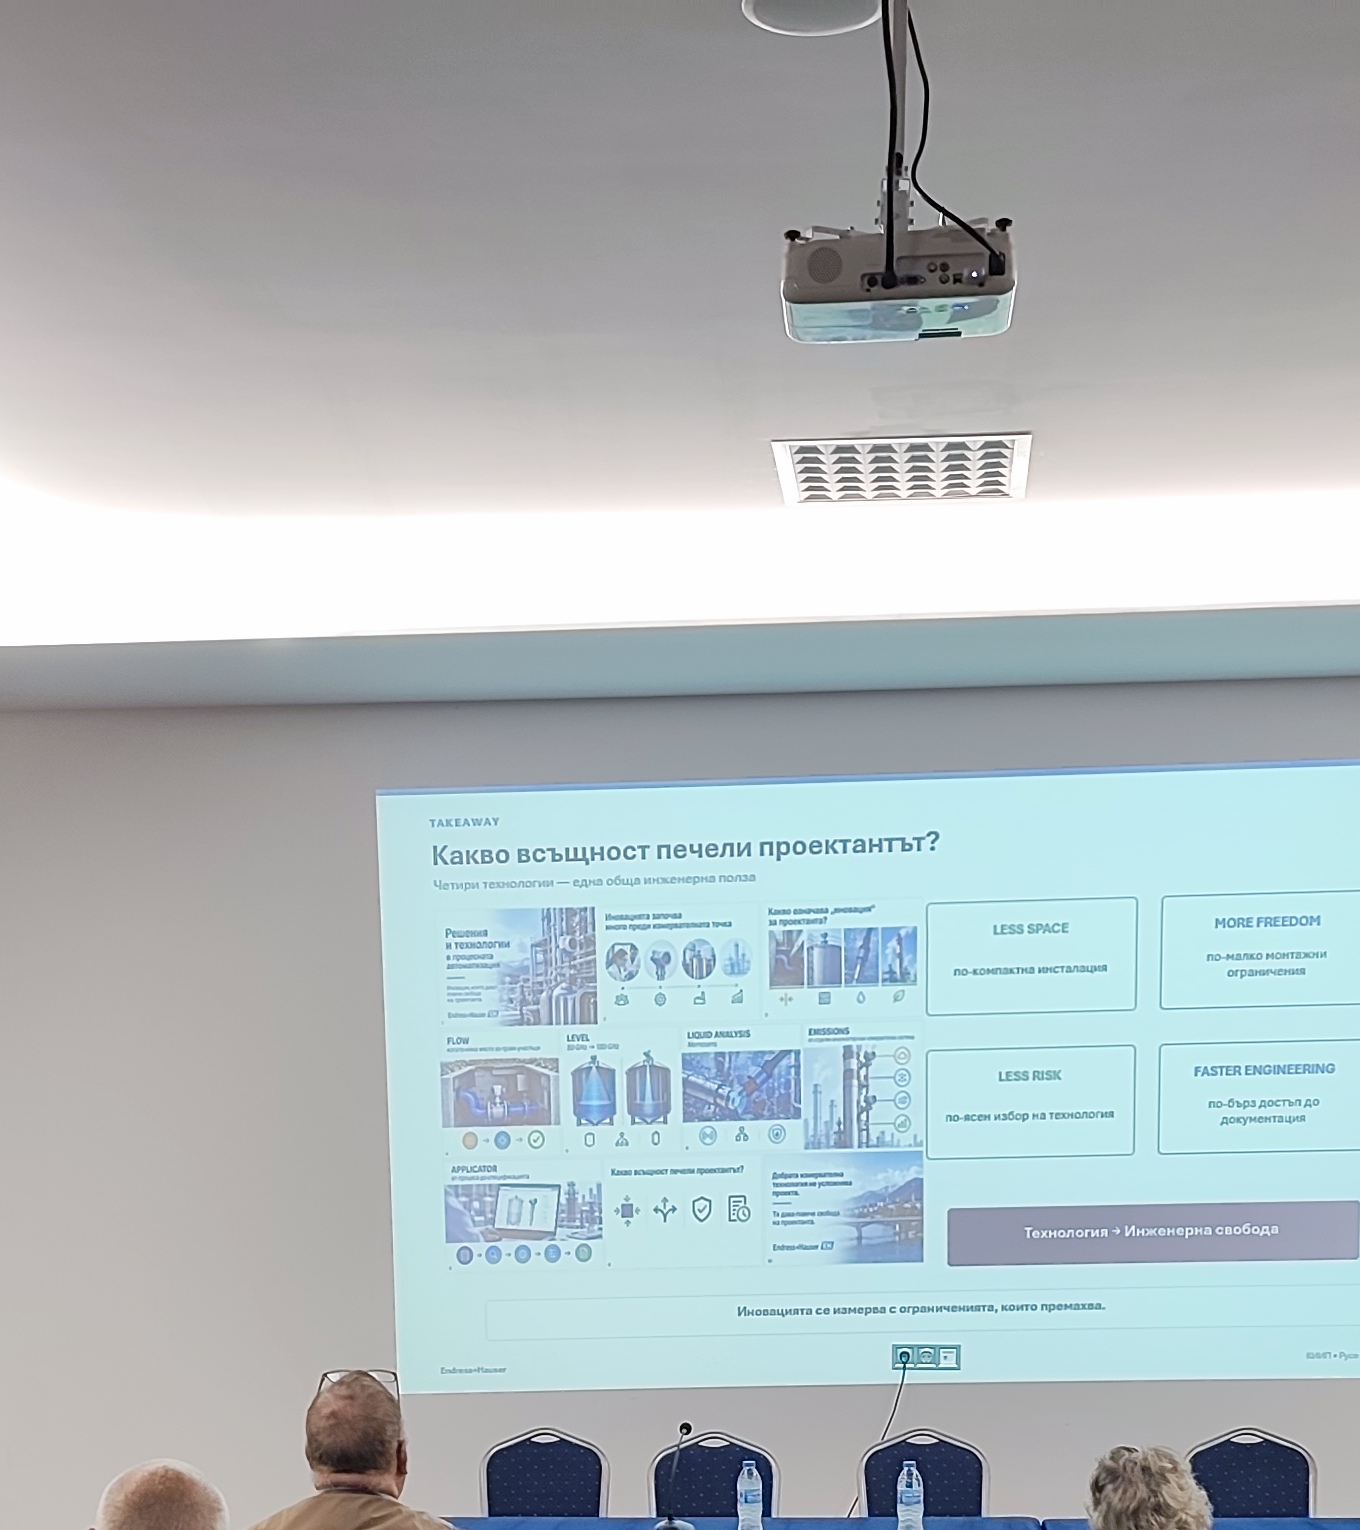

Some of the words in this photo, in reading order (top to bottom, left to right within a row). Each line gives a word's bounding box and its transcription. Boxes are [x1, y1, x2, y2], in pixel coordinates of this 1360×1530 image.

[429, 817, 499, 828] TAKEAWAY
[433, 845, 509, 865] Какво
[517, 845, 650, 865] всъщност
[657, 842, 751, 859] печели
[760, 831, 940, 861] проектантът?
[433, 880, 479, 891] Четири
[482, 879, 554, 889] технологии
[573, 879, 603, 888] една
[606, 875, 641, 887] обща
[644, 875, 716, 885] инженерна
[719, 874, 756, 882] полза
[1215, 917, 1253, 928] MORE
[1256, 915, 1320, 928] FREEDOM
[445, 928, 488, 938] Решения
[993, 924, 1024, 935] LESS
[1027, 922, 1069, 934] SPACE
[446, 942, 452, 950] и
[454, 941, 510, 949] технологии
[1207, 953, 1263, 961] по-малко
[1266, 951, 1327, 960] монтажни
[954, 967, 1035, 976] по-компактна
[1038, 964, 1107, 974] инсталация
[1227, 968, 1306, 979] ограничения
[687, 1031, 713, 1039] LIQUID
[714, 1030, 751, 1038] ANALYSIS
[808, 1027, 850, 1036] EMISSIONS
[447, 1037, 469, 1045] FLOW
[567, 1034, 590, 1042] LEVEL
[1194, 1065, 1242, 1077] FASTER
[1245, 1063, 1335, 1075] ENGINEERING
[999, 1071, 1029, 1082] LESS
[1032, 1070, 1062, 1081] RISK
[1208, 1098, 1256, 1110] по-бърз
[1258, 1099, 1302, 1109] достъп
[1303, 1099, 1320, 1108] до
[946, 1114, 991, 1122] по-ясен
[994, 1111, 1029, 1122] избор
[1032, 1112, 1046, 1120] на
[1049, 1111, 1114, 1120] технология
[1220, 1115, 1305, 1126] документация
[451, 1165, 497, 1173] APPLICATOR
[1024, 1227, 1108, 1238] Технология
[1125, 1225, 1212, 1239] Инженерна
[1215, 1223, 1278, 1236] свобода
[738, 1306, 812, 1317] Иновацията
[833, 1307, 886, 1316] измерва
[899, 1305, 998, 1315] ограниченията,
[1041, 1303, 1106, 1313] премахва.
